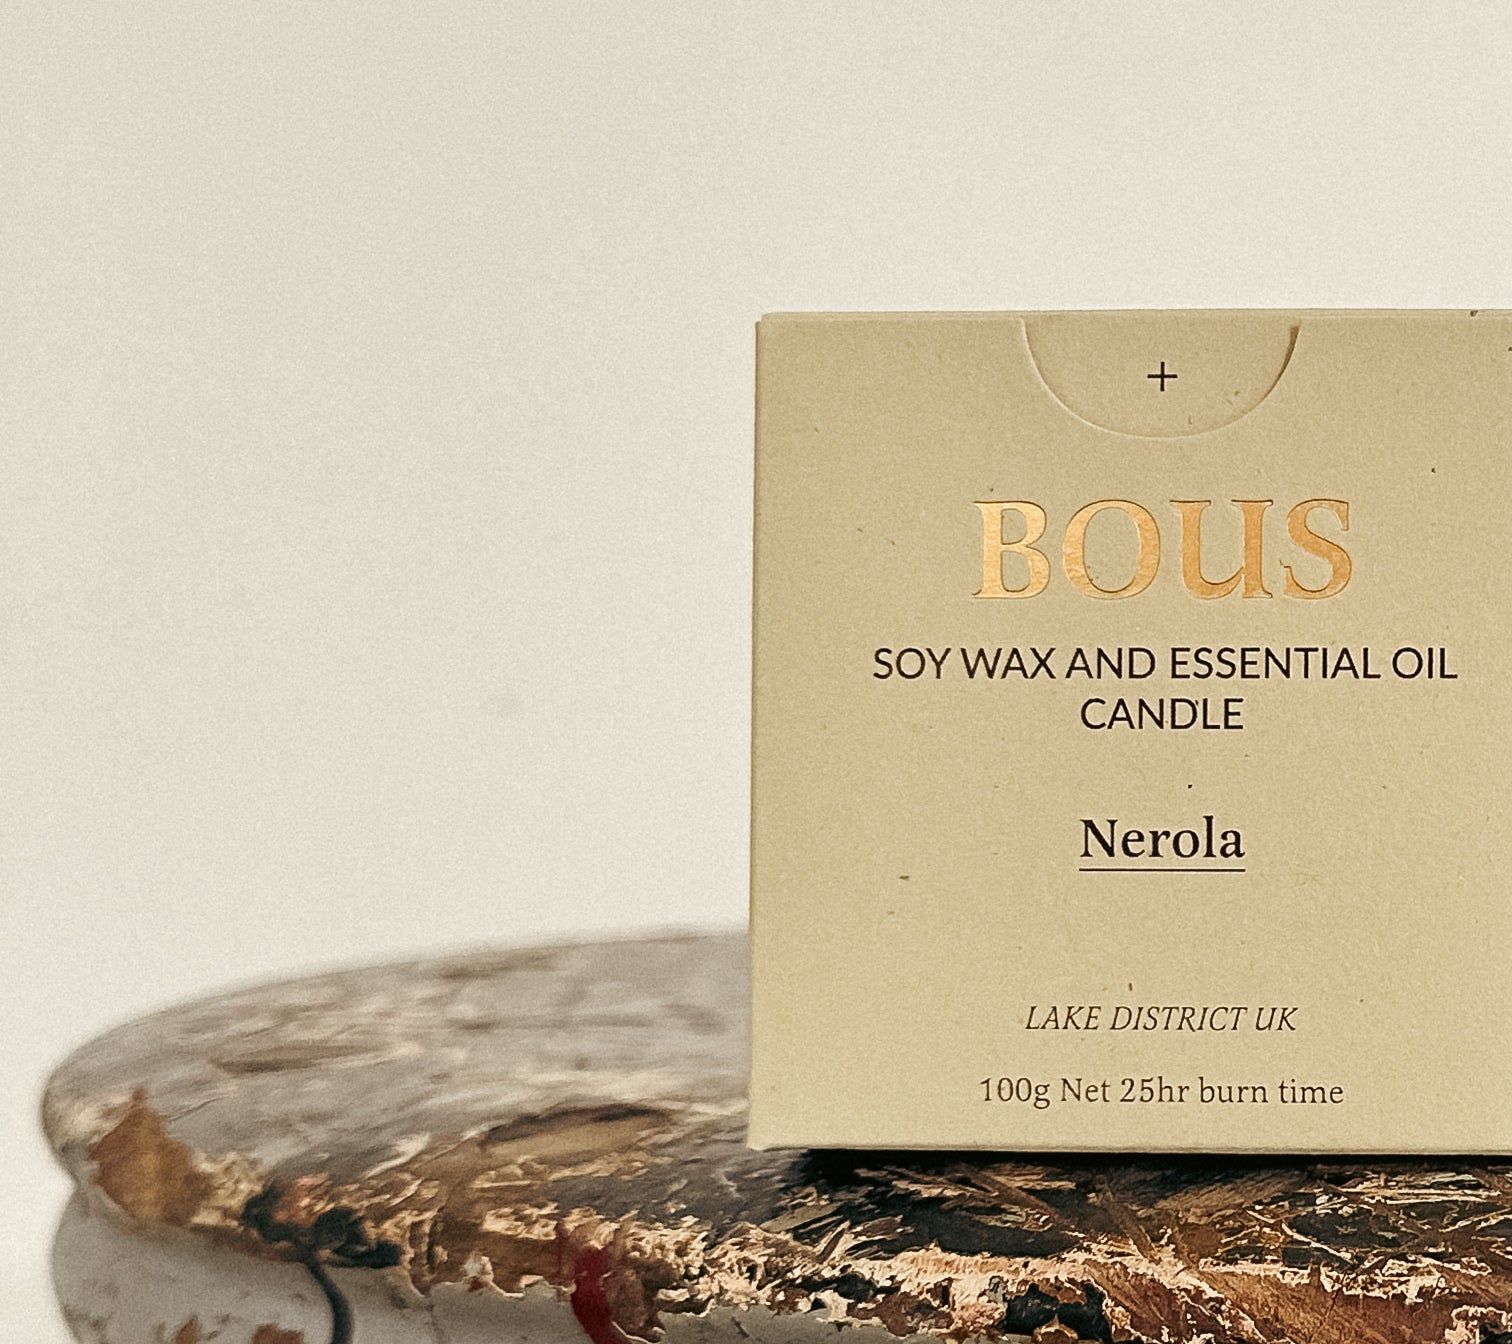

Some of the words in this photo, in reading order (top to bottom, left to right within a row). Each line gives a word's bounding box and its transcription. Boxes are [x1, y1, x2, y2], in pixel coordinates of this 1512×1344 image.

[972, 497, 1353, 600] BOUS
[872, 646, 951, 681] SOY
[959, 646, 1058, 681] WAX
[1064, 646, 1157, 680] AND
[1170, 646, 1381, 681] ESSENTIAL
[1389, 646, 1458, 681] OIL
[1080, 697, 1245, 731] CANDLE
[1079, 815, 1246, 861] Nerola
[1023, 1005, 1102, 1032] LAKE
[1109, 1005, 1248, 1033] DISTRICT
[1254, 1005, 1298, 1033] UK
[978, 1076, 1051, 1110] 100g
[1059, 1077, 1112, 1105] Net
[1118, 1076, 1191, 1105] 25hr
[1198, 1076, 1269, 1105] burn
[1277, 1076, 1345, 1105] time
